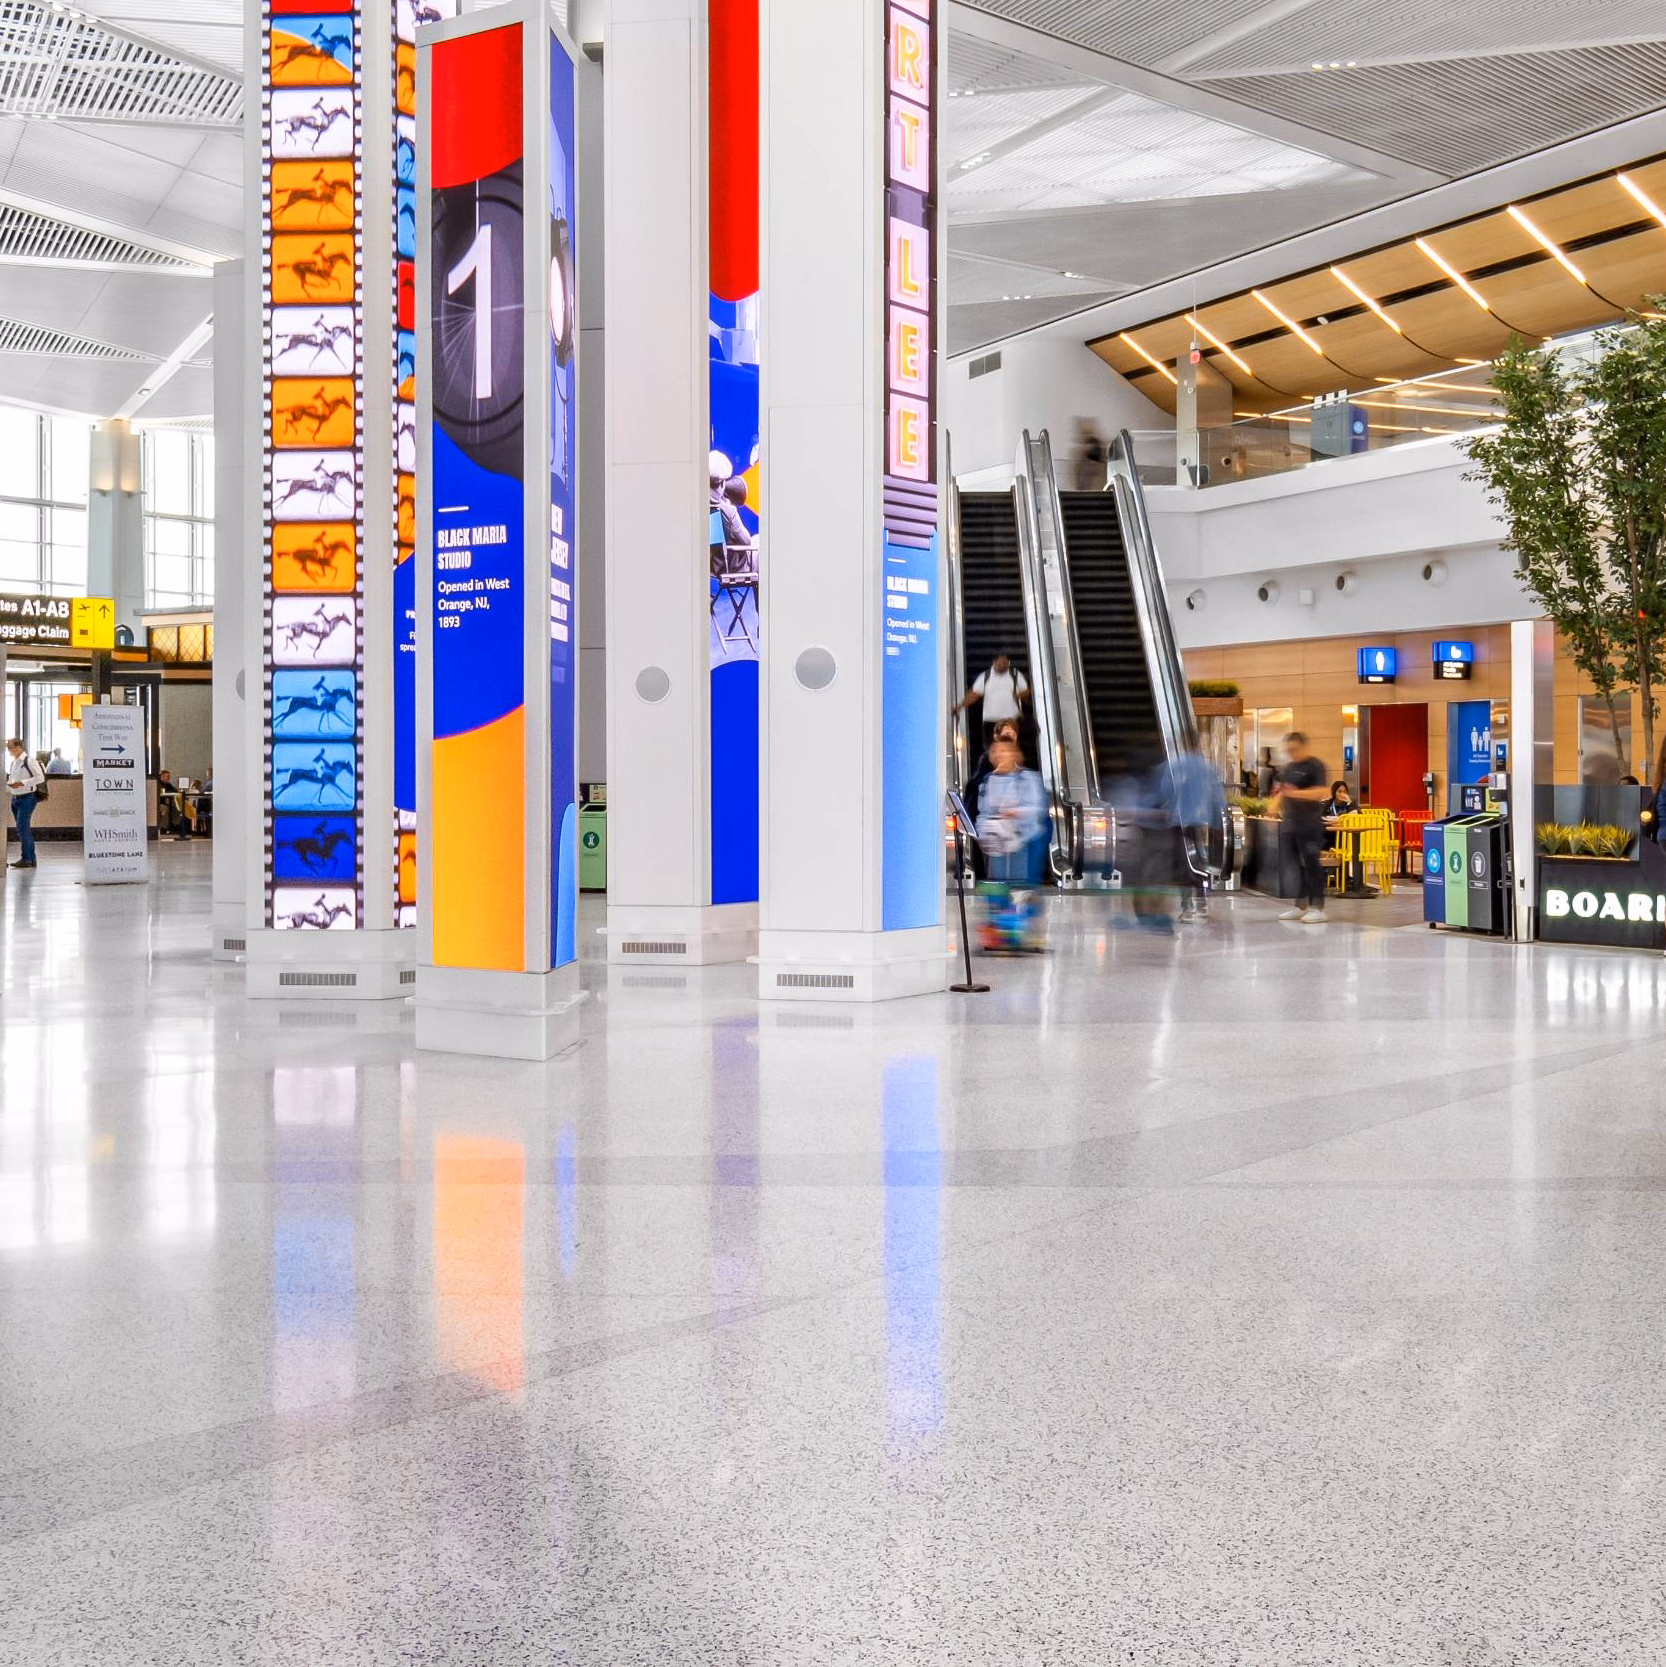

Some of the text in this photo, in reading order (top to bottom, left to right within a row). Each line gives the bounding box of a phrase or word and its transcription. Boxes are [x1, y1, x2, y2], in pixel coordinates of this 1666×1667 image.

[448, 223, 492, 400] 1
[897, 234, 923, 467] LEE
[438, 525, 507, 548] BLACK MARIA
[438, 551, 472, 570] STUDIO
[438, 577, 510, 595] Opened in West
[20, 598, 70, 619] A1-A8
[438, 596, 490, 612] Orange, NJ,
[438, 616, 461, 628] 1893
[37, 624, 70, 639] Claim
[96, 759, 132, 769] MARKET
[95, 779, 134, 789] TOWN
[94, 828, 138, 839] WHSmith
